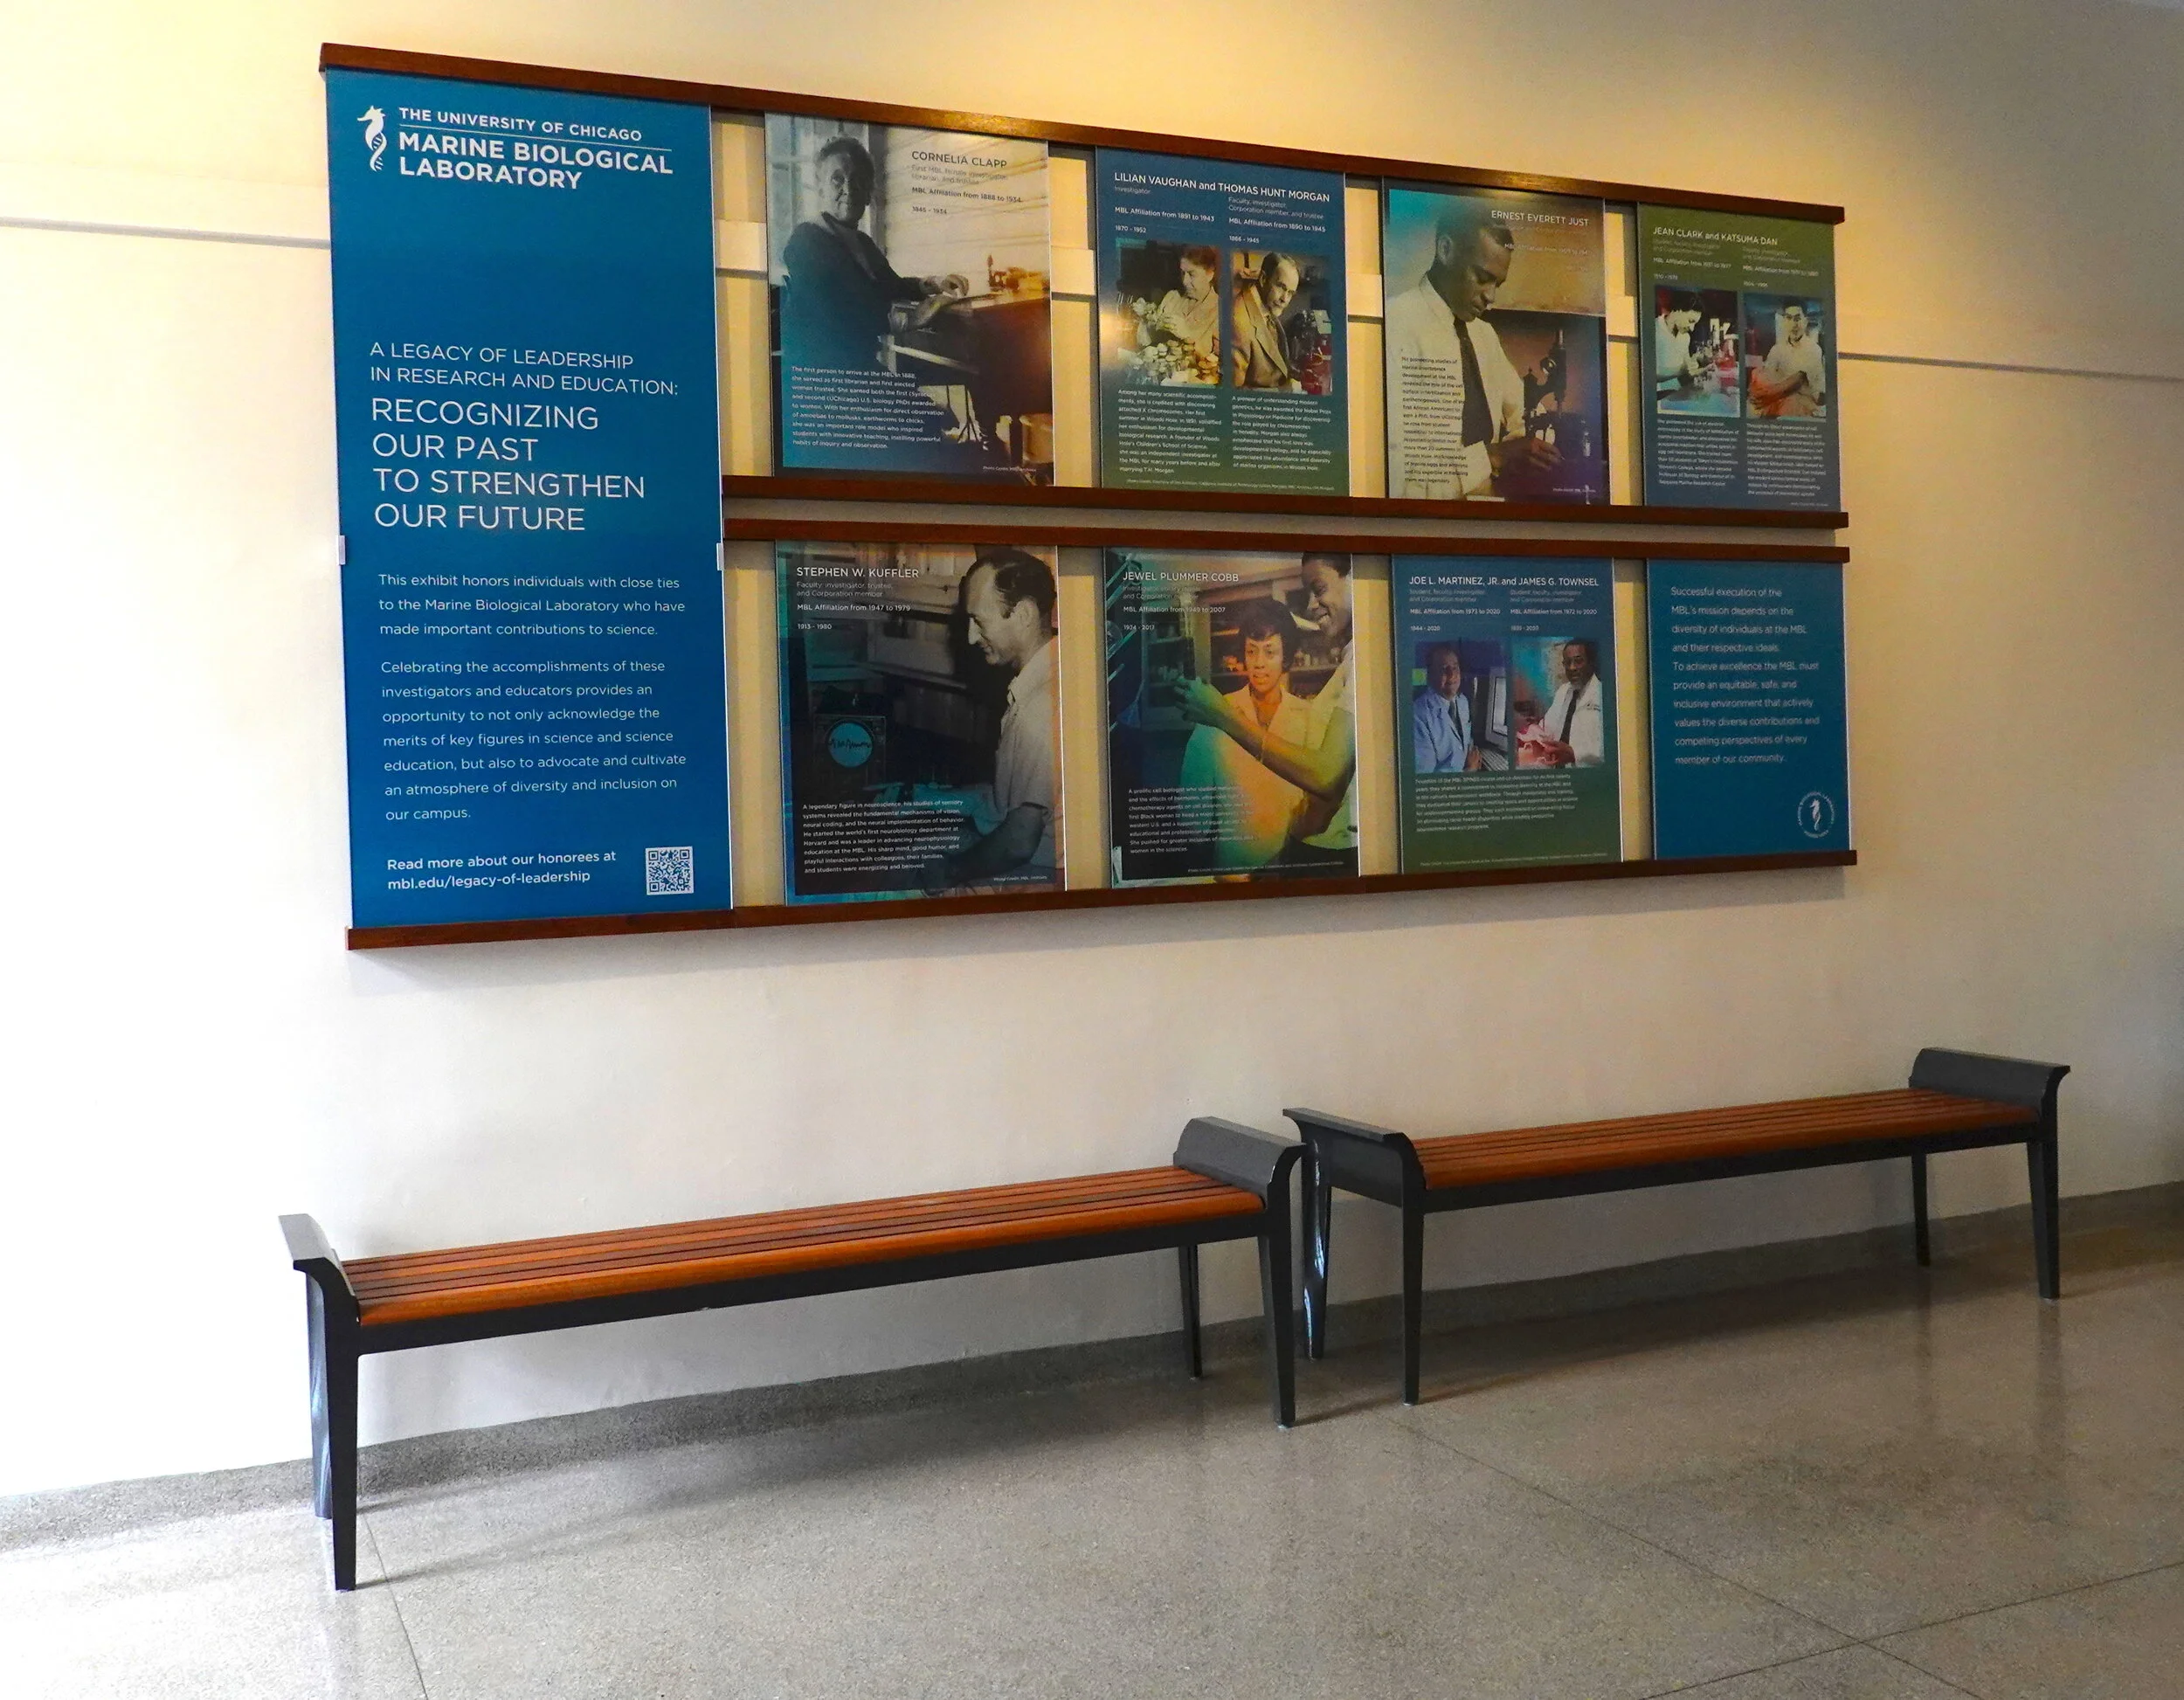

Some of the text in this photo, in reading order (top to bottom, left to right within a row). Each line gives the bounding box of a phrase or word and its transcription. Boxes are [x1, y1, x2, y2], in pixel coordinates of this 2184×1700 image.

[398, 107, 642, 142] THE UNIVERSITY OF CHICAGO
[398, 132, 674, 175] MARINE BIOLOGICAL
[911, 150, 1007, 169] CORNELIA CLAPP
[399, 156, 582, 190] LABORATORY
[1114, 171, 1330, 204] LILIAN VAUGHAN and THOMAS HUNT MORGAN
[1490, 210, 1588, 227] ERNEST EVERETT JUST
[1652, 226, 1778, 246] JEAN CLARK and KATSUMA DAN
[370, 342, 633, 370] A LEGACY OF LEADERSHIP
[370, 366, 678, 396] IN RESEARCH AND EDUCATION:
[371, 397, 598, 431] RECOGNIZING
[372, 432, 539, 461] OUR PAST
[372, 467, 644, 499] TO STRENGTHEN
[374, 502, 585, 531] OUR FUTURE
[377, 573, 680, 589] This exhibit honors individuals with close ties
[796, 566, 919, 579] STEPHEN W. KUFFLER
[1122, 571, 1239, 583] JEWEL PLUMMER COBB
[1408, 576, 1600, 587] JOE L. MARTINEZ, JR. and JAMES G. TOWNSEL
[378, 598, 686, 614] to the Marine Biological Laboratory who have
[379, 623, 658, 638] made important contributions to science.
[380, 660, 666, 675] Celebrating the accomplishments of these
[382, 683, 653, 700] investigators and educators provides an
[382, 707, 660, 725] opportunity to not only acknowledge the
[383, 731, 674, 748] merits of key figures in science and science
[384, 754, 687, 772] education, but also to advocate and cultivate
[384, 777, 677, 797] an atmosphere of diversity and inclusion on
[385, 809, 471, 821] our campus.
[387, 850, 616, 871] Read more about our honorees at
[387, 871, 591, 890] mbl.edu/legacy-of-leadership
